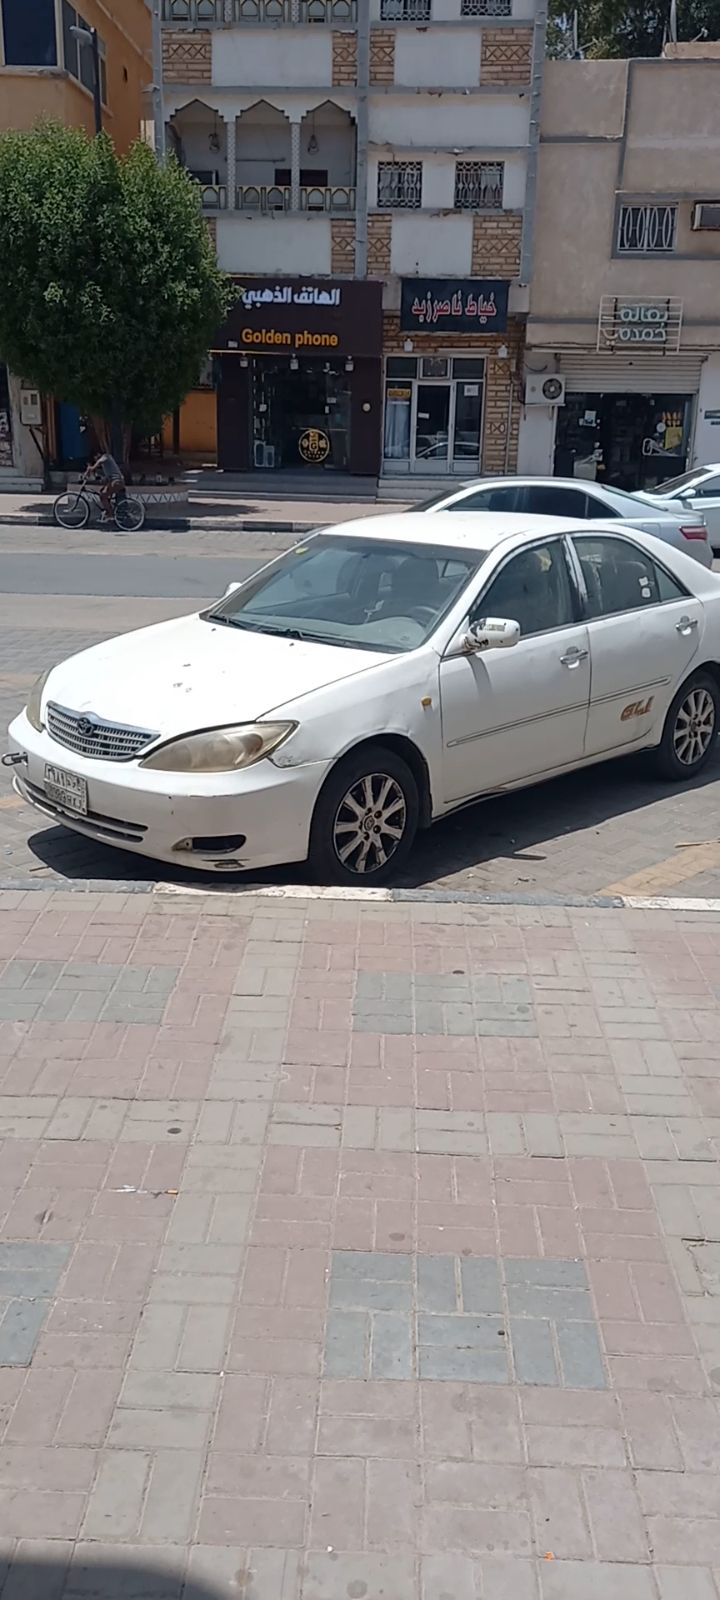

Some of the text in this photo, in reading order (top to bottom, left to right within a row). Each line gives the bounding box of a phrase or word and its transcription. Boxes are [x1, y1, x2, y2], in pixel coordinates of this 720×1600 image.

[242, 286, 341, 309] الهاتف الذهبي
[411, 290, 497, 324] خياط ناصر زيد
[242, 328, 338, 348] Golden phone
